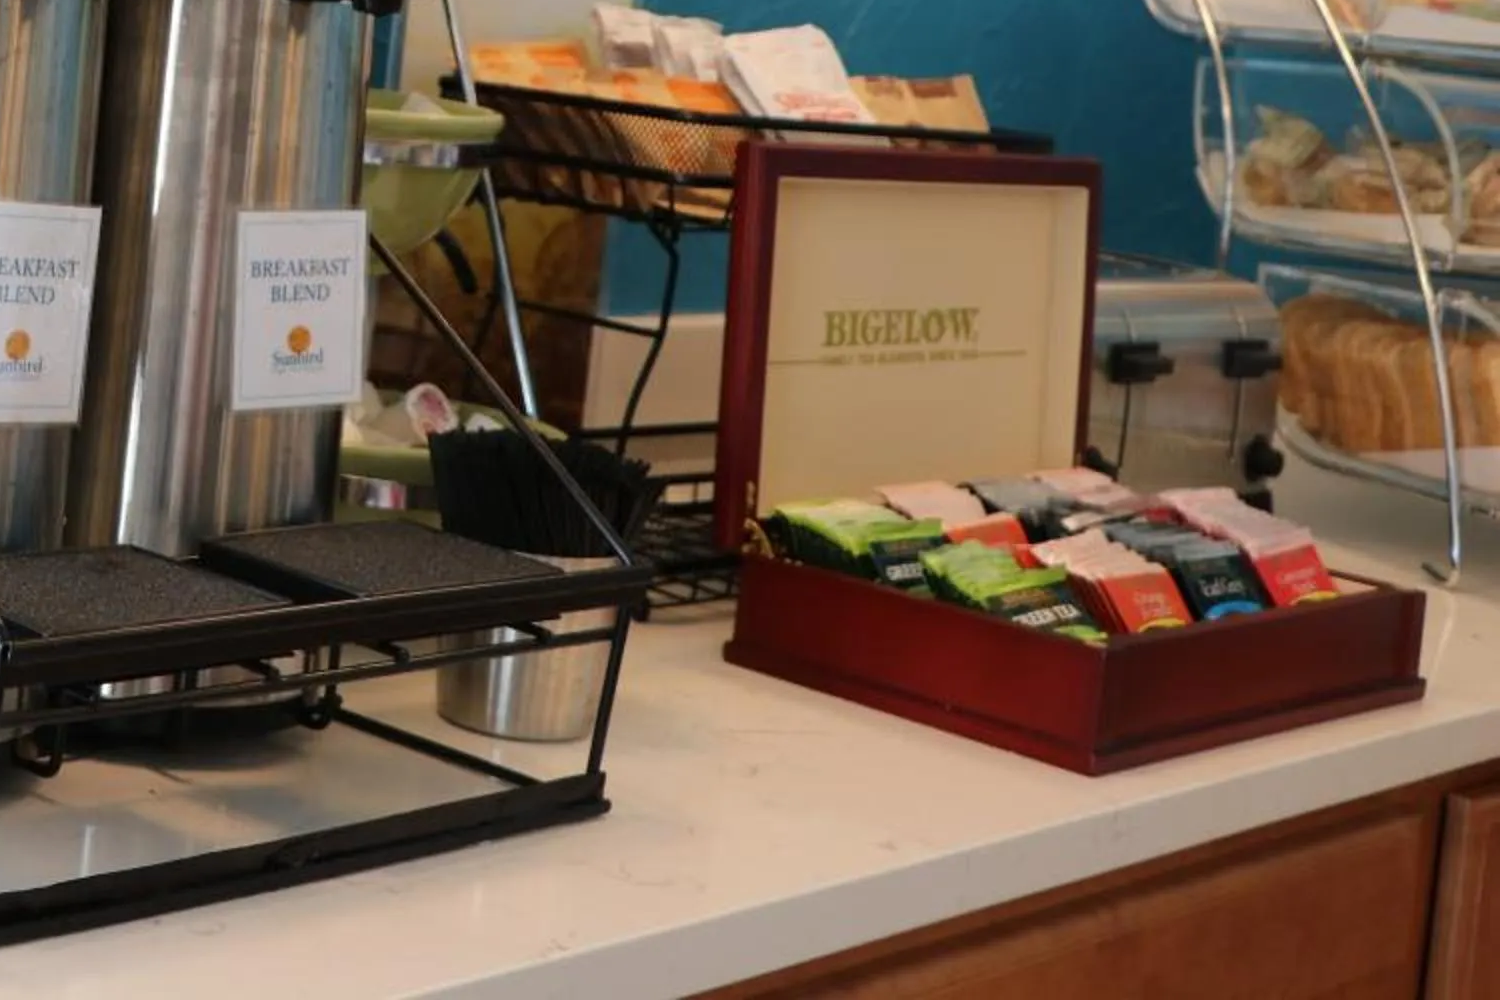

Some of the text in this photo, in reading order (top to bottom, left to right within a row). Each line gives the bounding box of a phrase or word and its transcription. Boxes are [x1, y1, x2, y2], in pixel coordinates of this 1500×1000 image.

[250, 257, 351, 279] BREAKFAST
[270, 283, 331, 303] BLEND
[821, 306, 981, 347] BIGELOW
